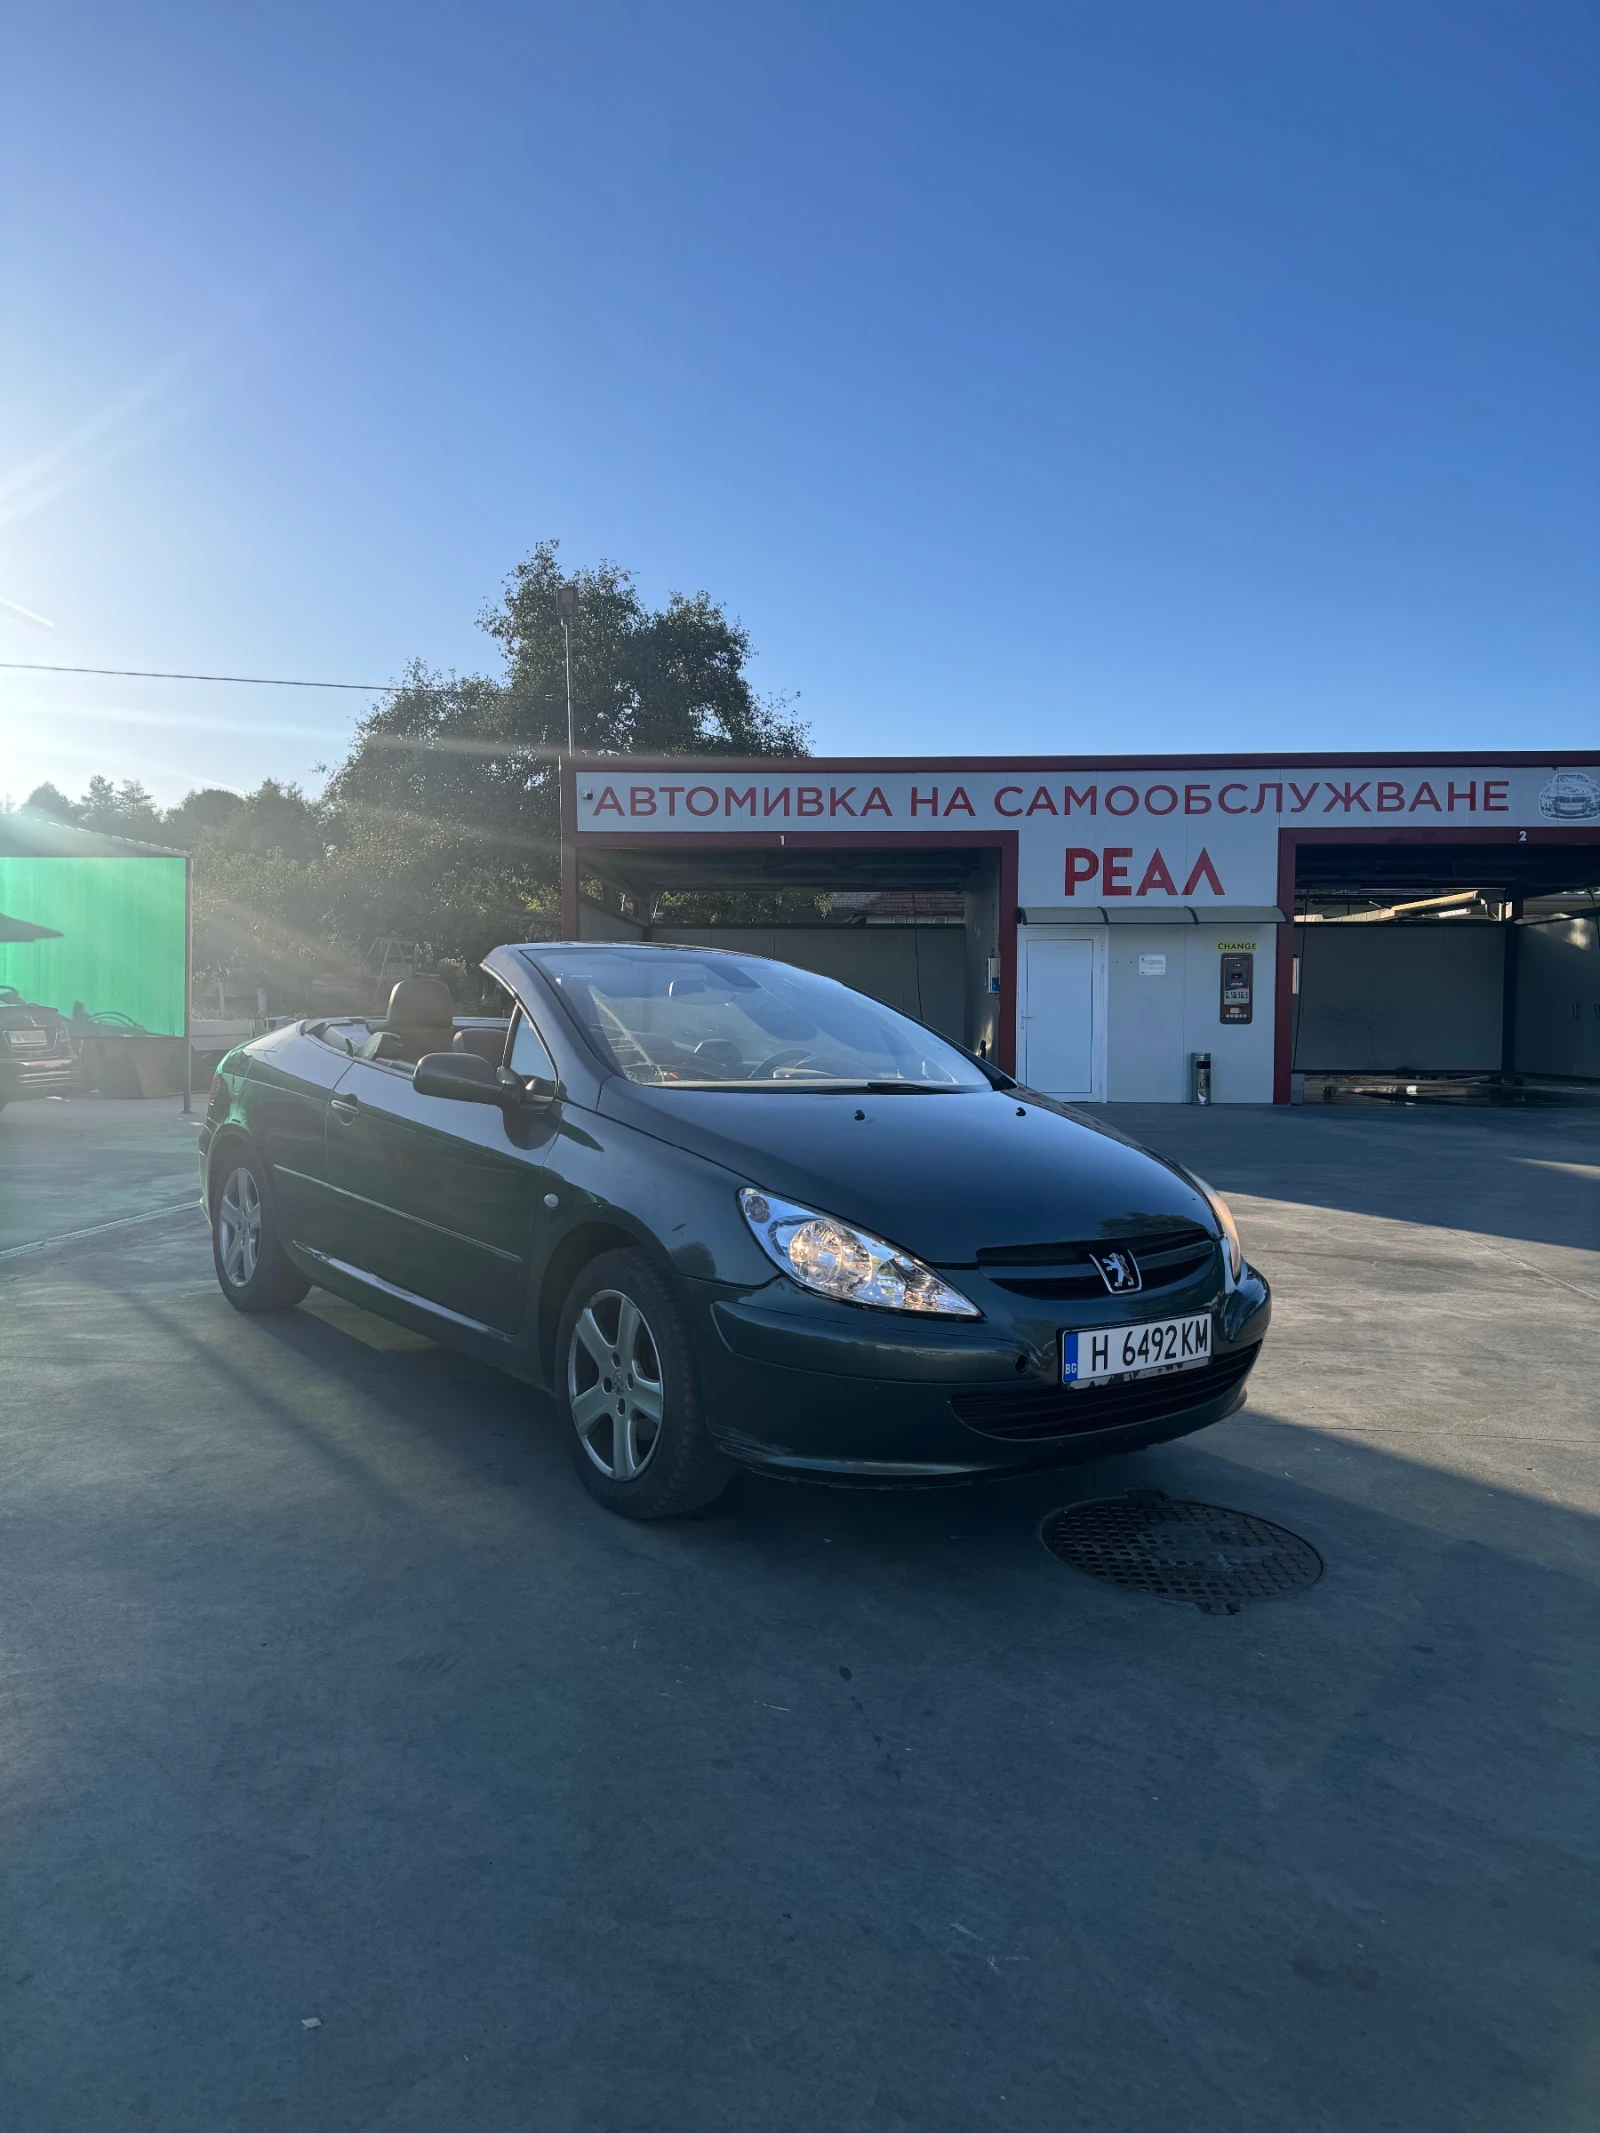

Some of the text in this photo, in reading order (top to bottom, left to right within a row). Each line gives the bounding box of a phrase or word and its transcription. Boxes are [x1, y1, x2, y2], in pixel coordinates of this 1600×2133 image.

[593, 781, 1509, 817] АВТОМИВКА НА САМООБСЛУЖВАНЕ
[779, 835, 785, 846] 1
[1518, 830, 1527, 842] 2
[1065, 847, 1226, 896] РЕАЛ
[1217, 942, 1257, 950] CHANGE
[1065, 1363, 1077, 1375] BG
